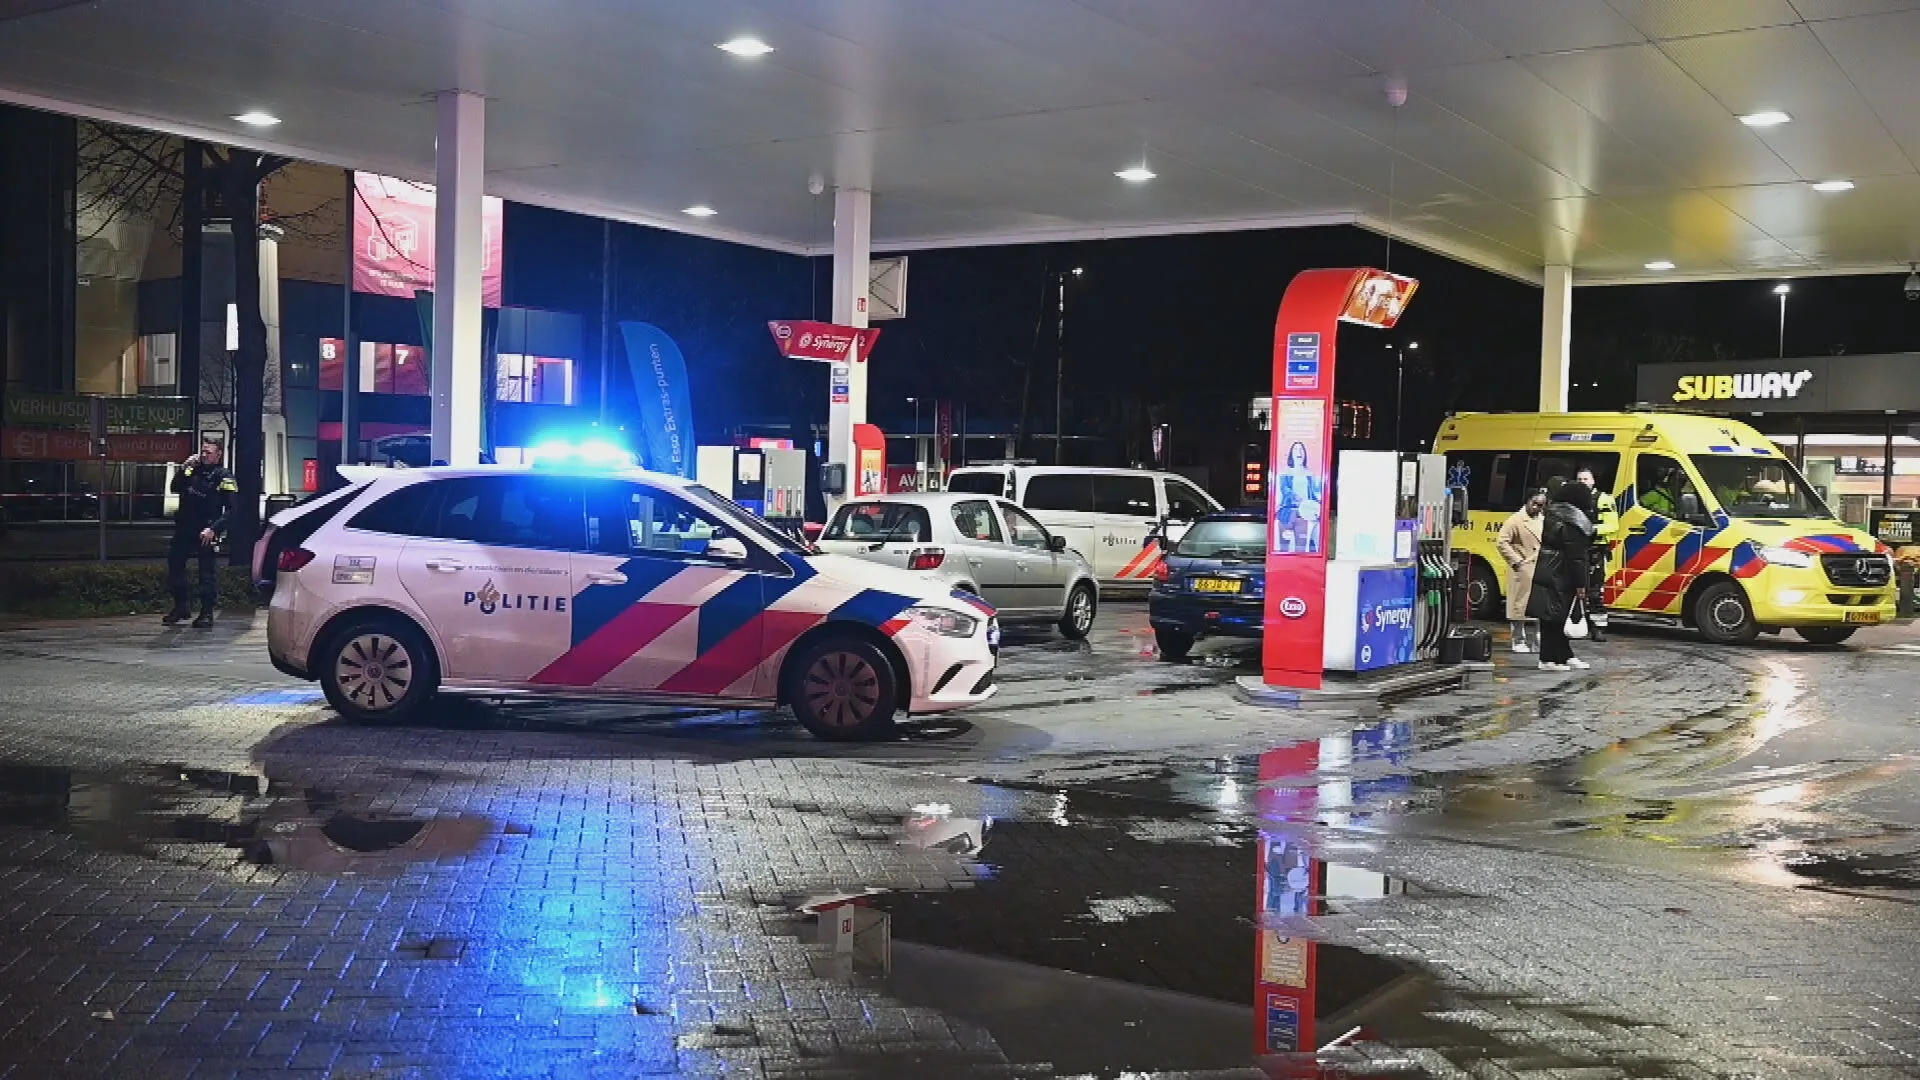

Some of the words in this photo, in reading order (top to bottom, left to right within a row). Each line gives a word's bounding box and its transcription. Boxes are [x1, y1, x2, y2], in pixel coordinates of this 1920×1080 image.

[322, 343, 336, 359] 8
[812, 335, 848, 352] Synergy
[396, 349, 409, 365] 7
[650, 343, 677, 433] Extras-punten
[1672, 369, 1813, 402] SUBWAY
[10, 399, 123, 418] VERHUISDEN
[130, 405, 146, 420] TE
[150, 407, 185, 422] KOOP
[1102, 534, 1136, 546] POLITIE
[464, 590, 566, 614] POLITIE
[1375, 605, 1412, 632] Synergy
